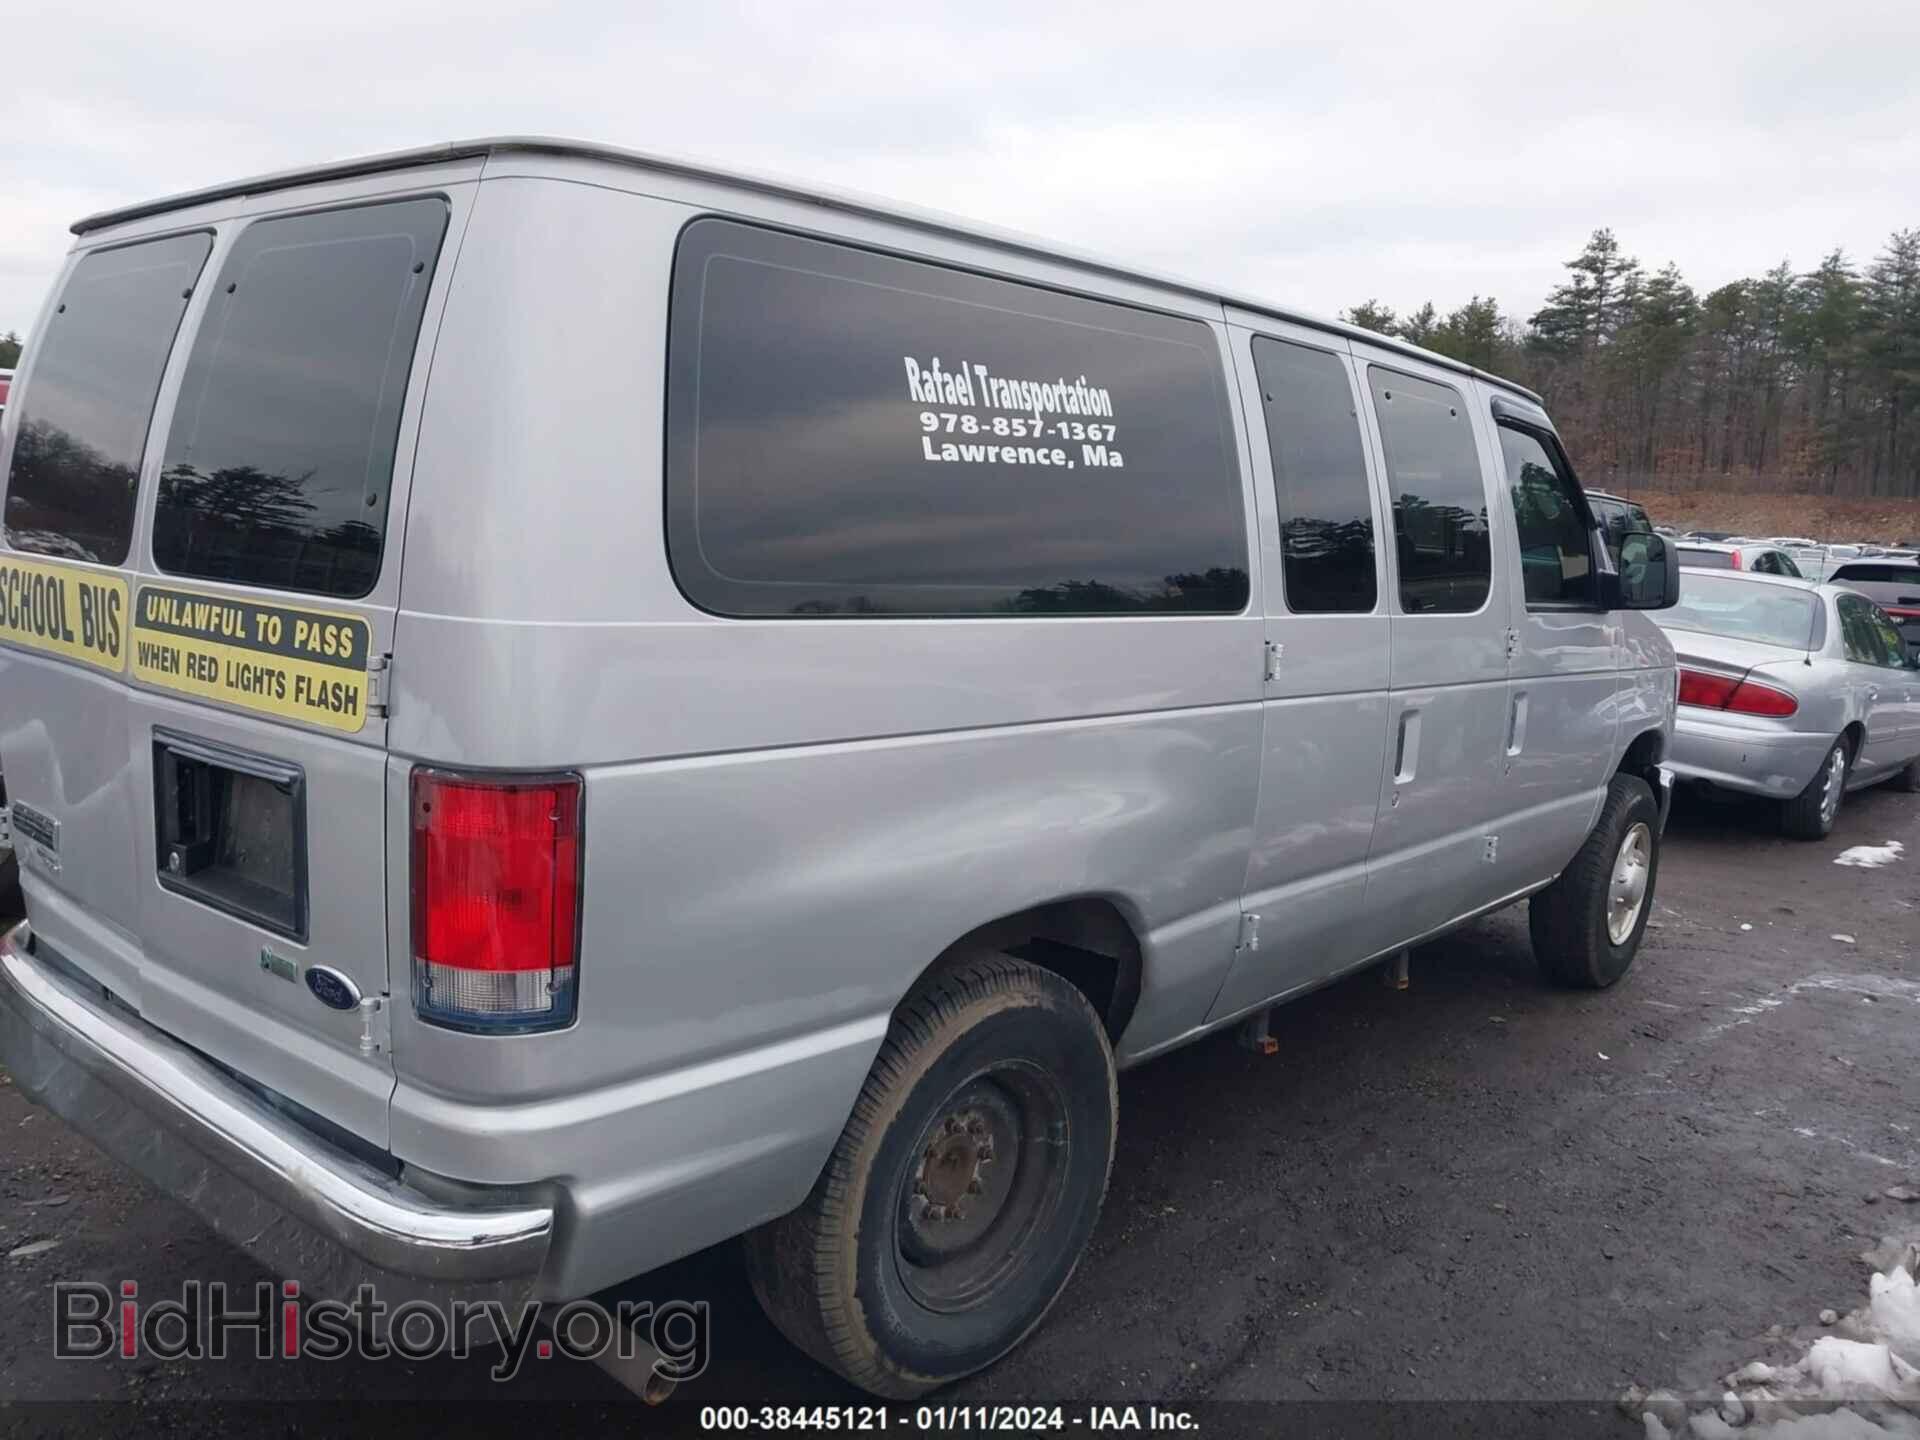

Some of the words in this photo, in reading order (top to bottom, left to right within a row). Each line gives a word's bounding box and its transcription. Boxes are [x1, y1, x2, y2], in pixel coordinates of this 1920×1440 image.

[904, 356, 976, 406] Rafael
[973, 364, 1113, 419] Transportation
[919, 411, 1116, 442] 978-857-1367
[921, 435, 1075, 469] Lawrence,
[1081, 444, 1124, 468] Ma
[78, 581, 121, 658] BUS
[146, 594, 246, 639] UNLAWFUL
[256, 612, 282, 646] TO
[294, 619, 354, 660] PASS
[138, 641, 181, 676] WHEN
[186, 651, 219, 684] RED
[225, 659, 286, 700] LIGHTS
[294, 674, 359, 717] FLASH
